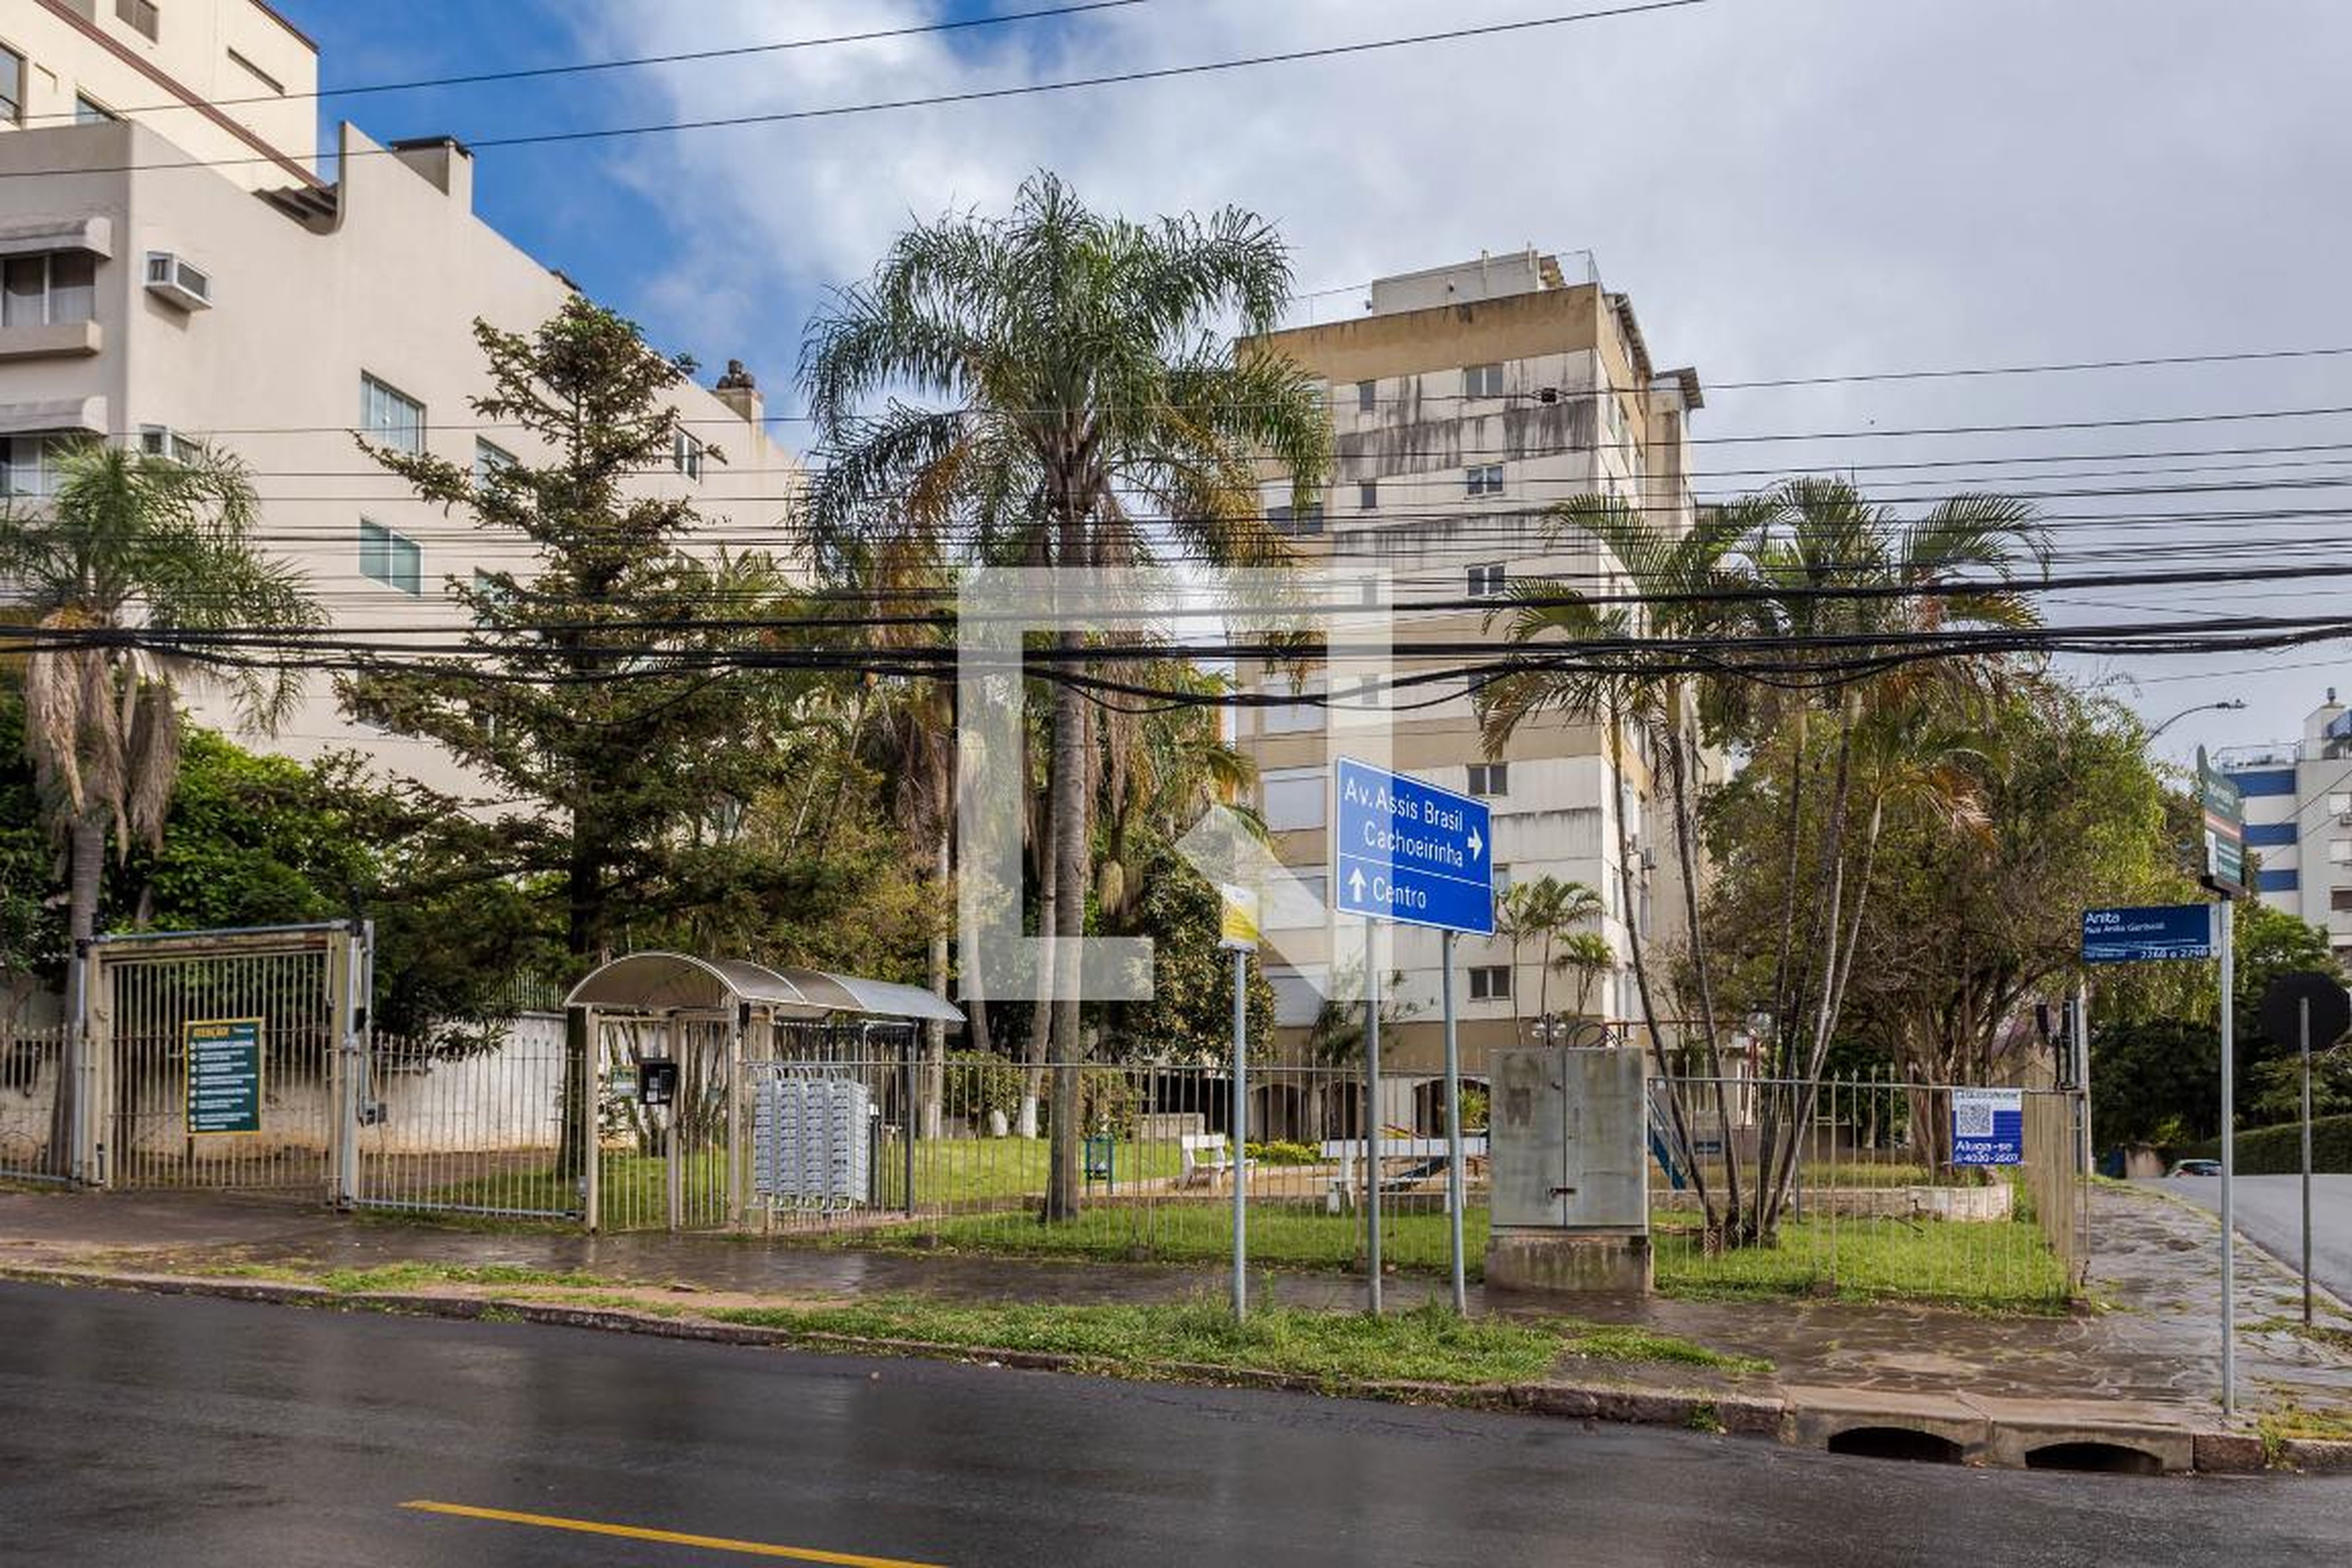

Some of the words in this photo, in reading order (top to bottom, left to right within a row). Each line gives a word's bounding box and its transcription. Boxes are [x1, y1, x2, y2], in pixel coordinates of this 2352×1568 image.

[1424, 800, 1463, 832] Brasil
[1364, 821, 1463, 867] Cachoeirinha
[1373, 876, 1427, 909] Centro
[2085, 911, 2120, 924] Anita
[2084, 926, 2101, 935] Rua
[2103, 924, 2125, 933] Anita
[1956, 1140, 2014, 1153] Aluga-se
